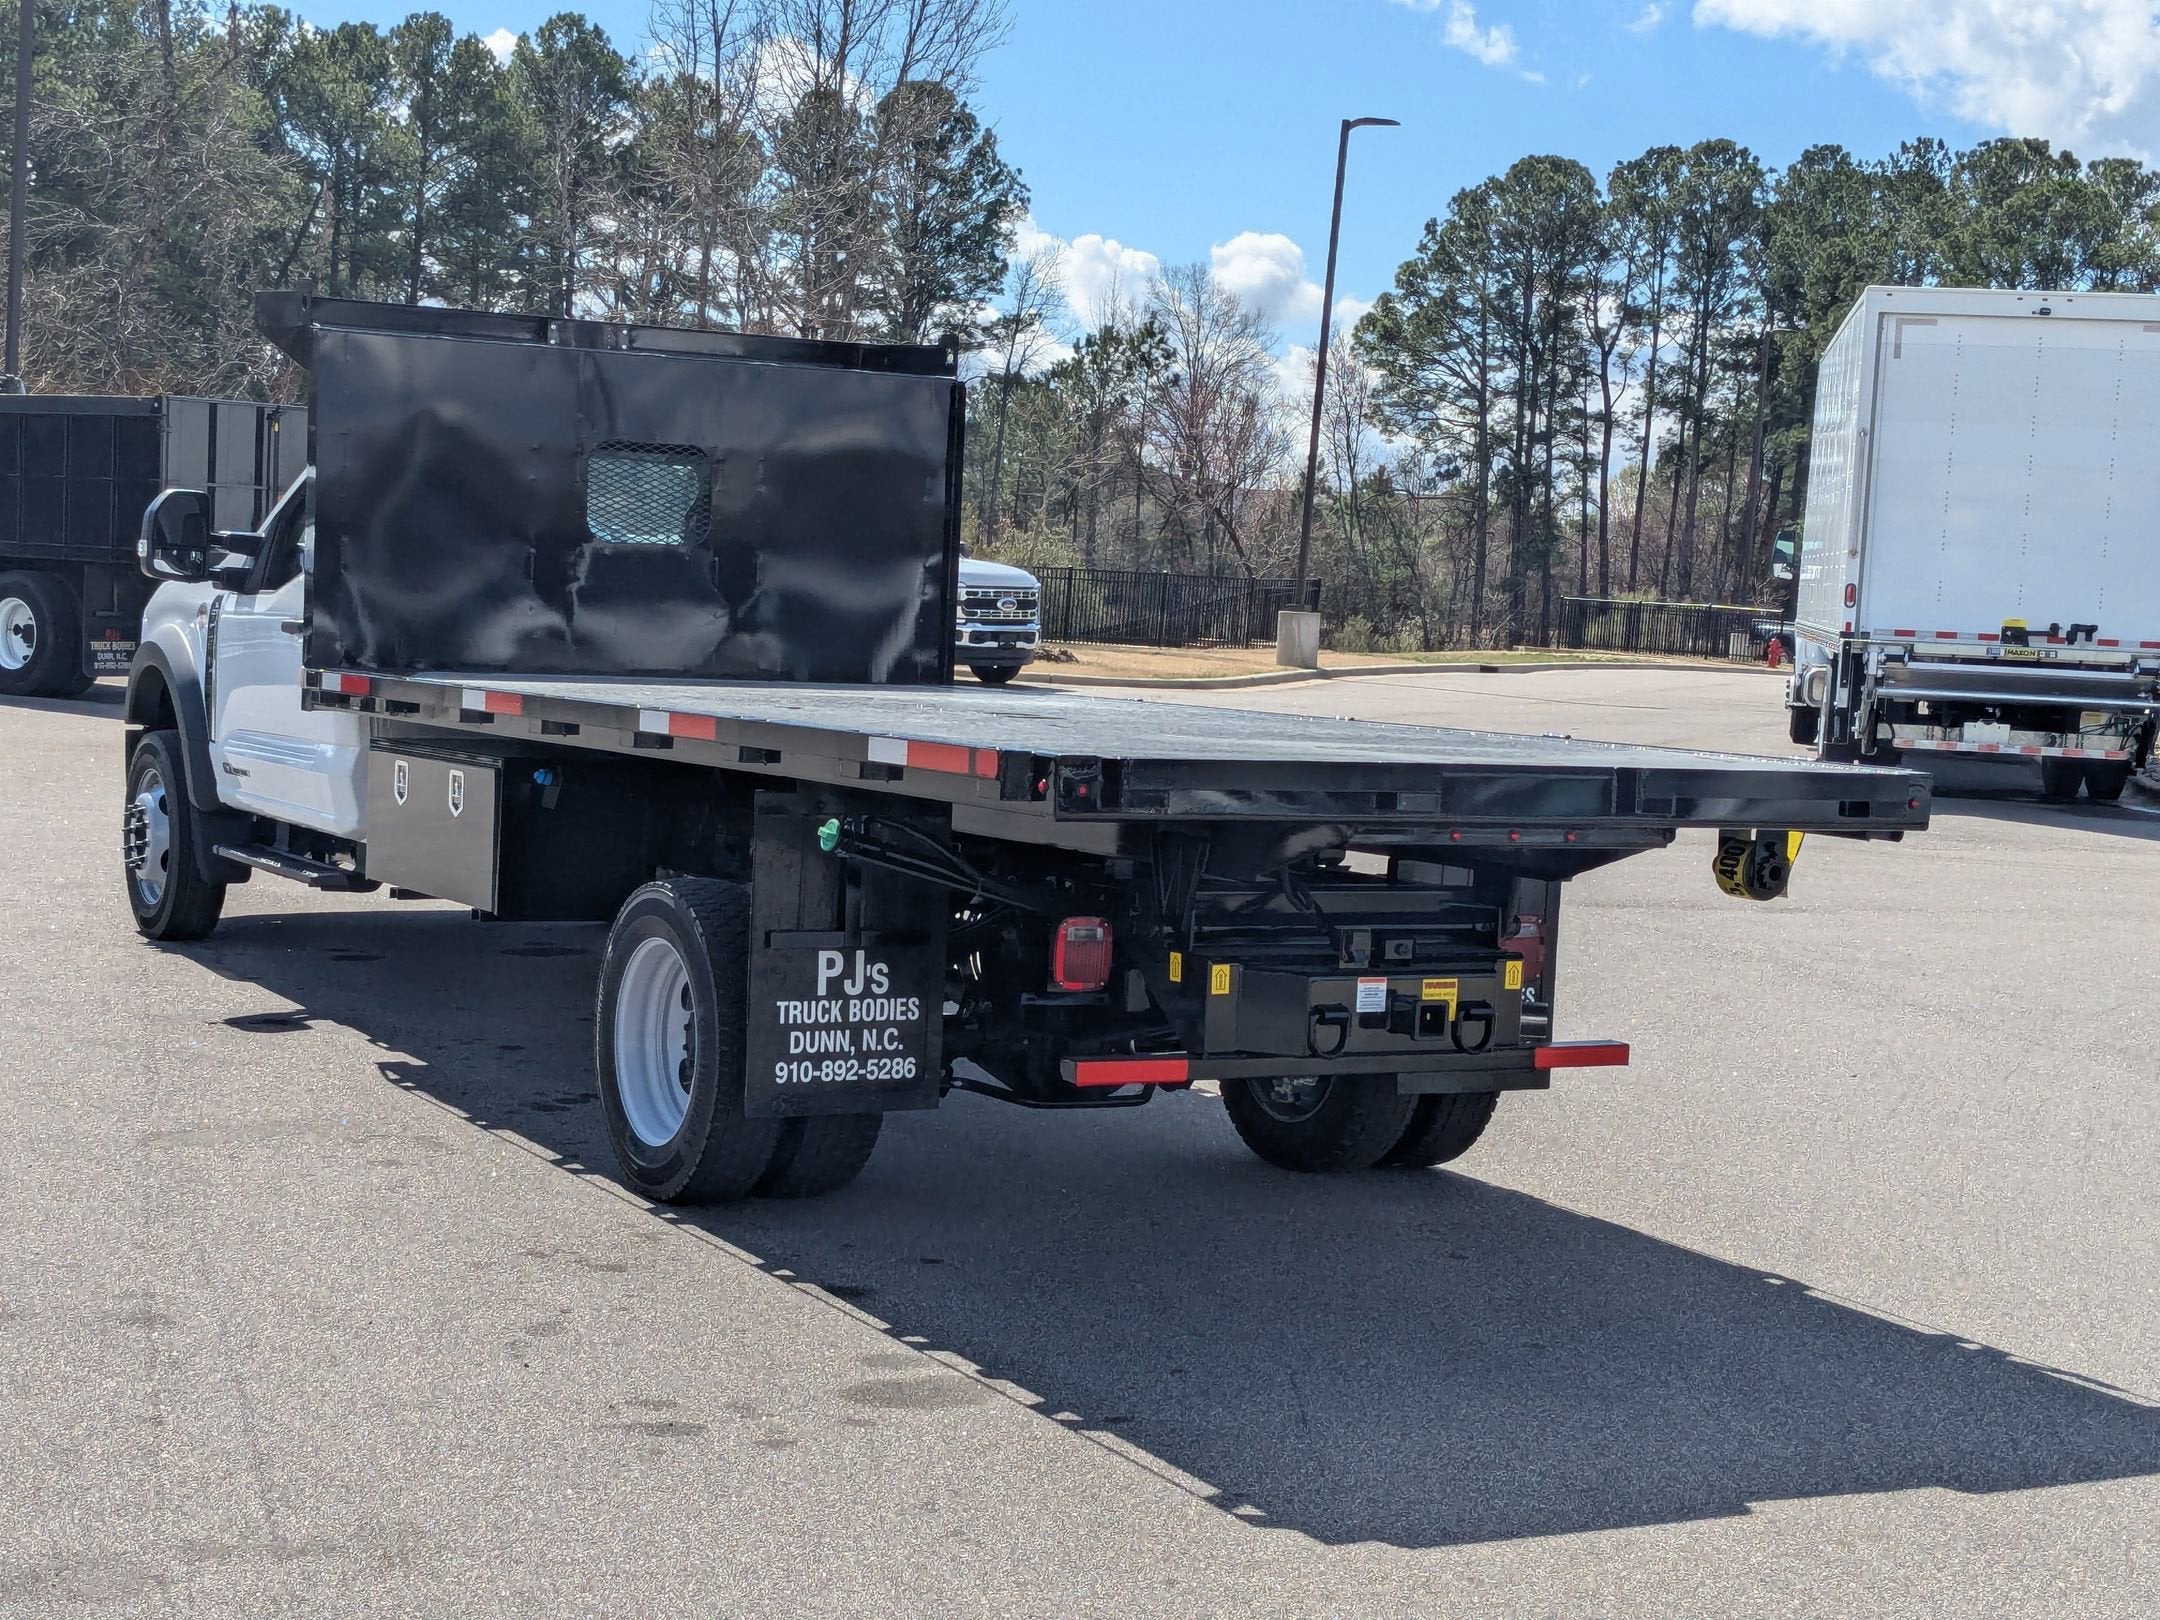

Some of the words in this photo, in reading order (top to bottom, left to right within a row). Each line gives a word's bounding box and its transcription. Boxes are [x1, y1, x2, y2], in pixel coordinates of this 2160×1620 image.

[2007, 648, 2036, 657] MAXON
[776, 1000, 843, 1024] TRUCK
[849, 998, 920, 1023] BODIES
[789, 1029, 855, 1056] DUNN,
[862, 1027, 904, 1052] N.C.
[775, 1057, 916, 1084] 910-892-5286
